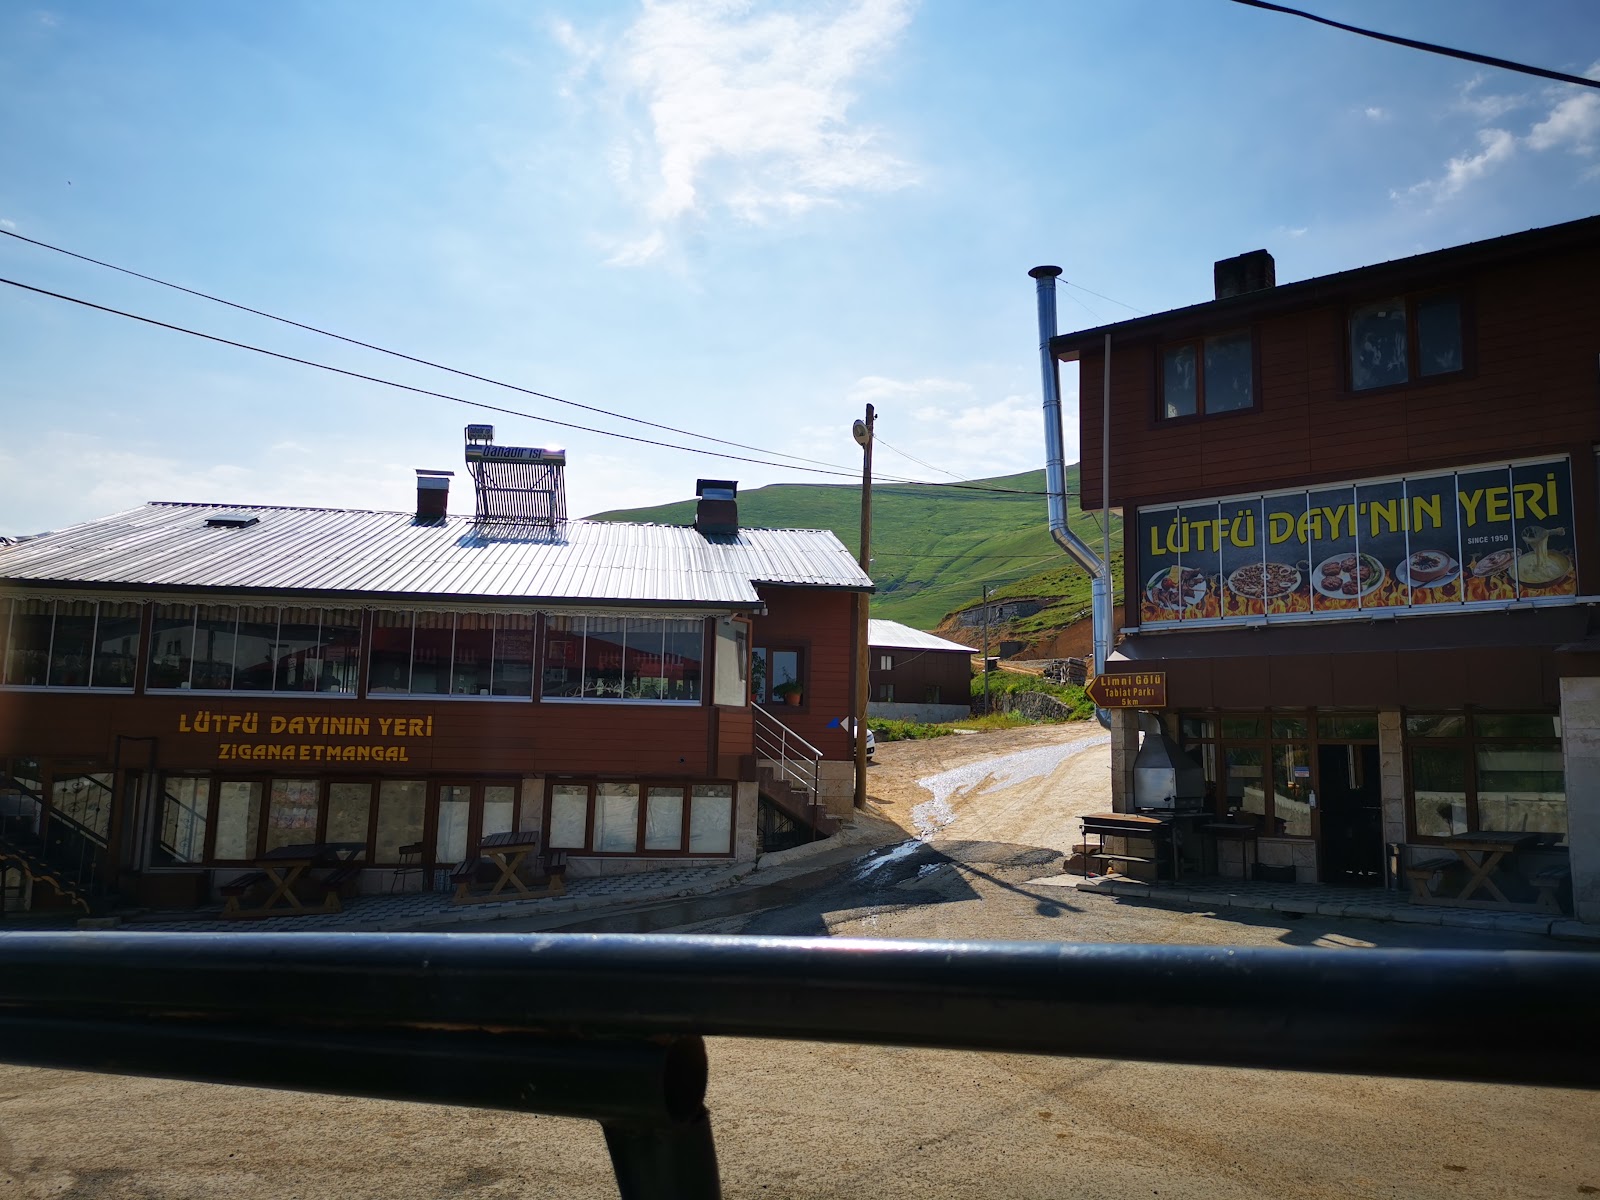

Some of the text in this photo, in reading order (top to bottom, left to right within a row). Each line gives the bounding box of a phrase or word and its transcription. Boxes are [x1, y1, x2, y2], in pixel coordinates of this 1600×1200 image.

[1151, 472, 1559, 556] LÜTFÜ DAYI'NIN YERİ
[1467, 534, 1509, 545] SINCE 1950
[1100, 674, 1161, 686] Limni Gölü
[1133, 687, 1155, 696] Parkı
[179, 711, 433, 737] LÜTFÜ DAYININ YERİ
